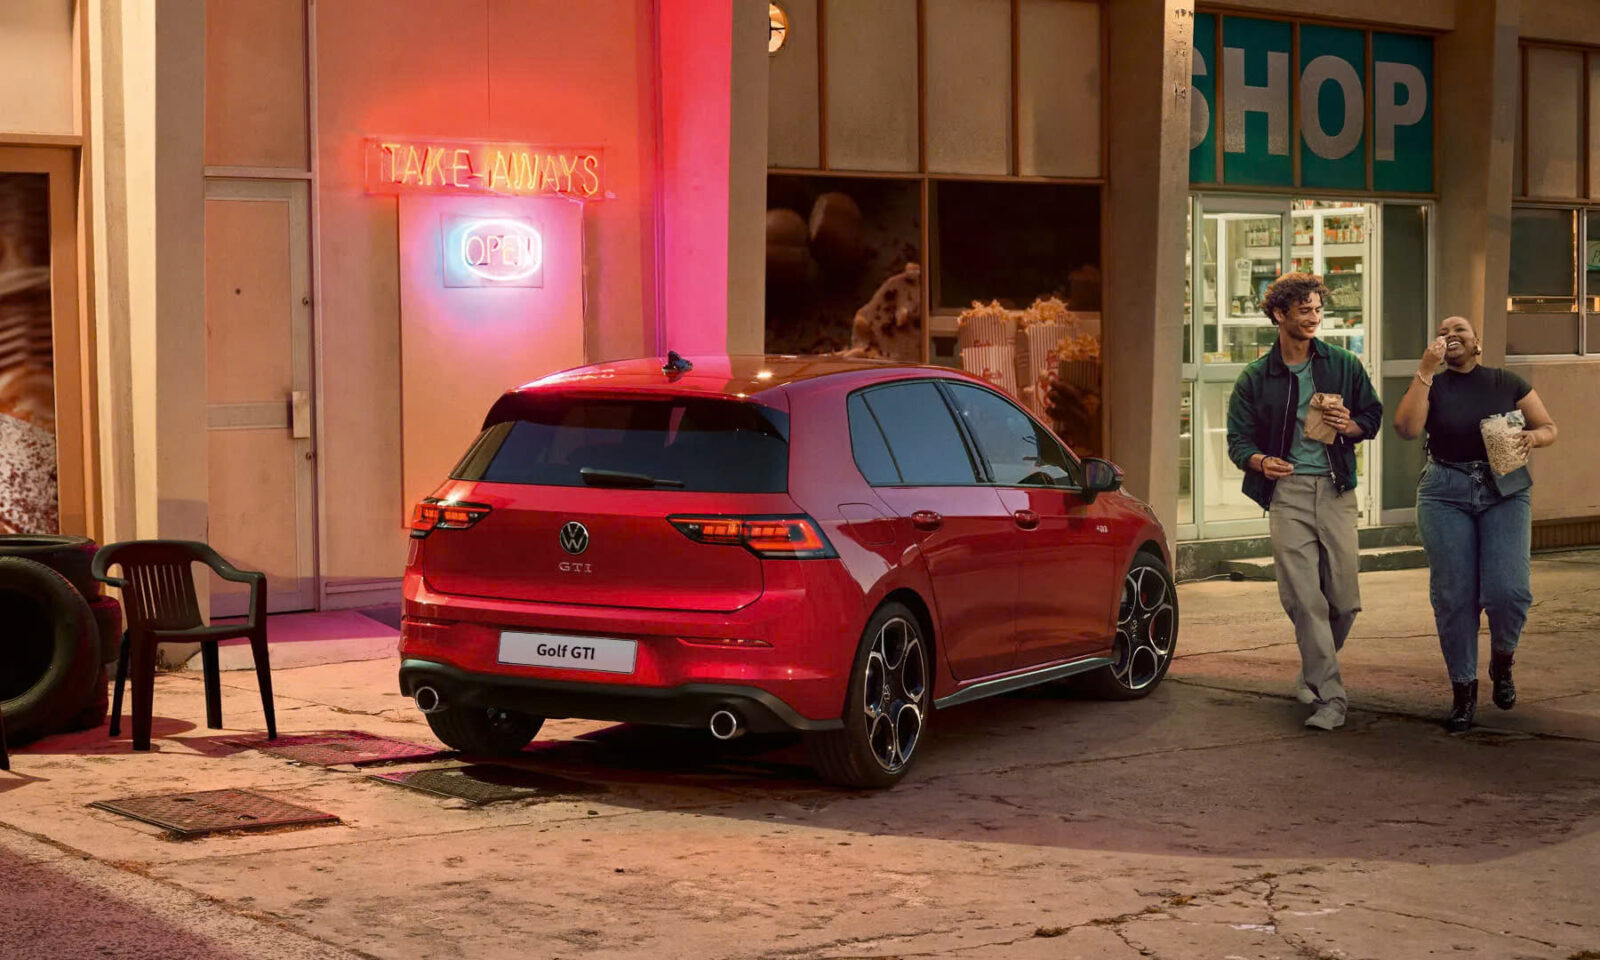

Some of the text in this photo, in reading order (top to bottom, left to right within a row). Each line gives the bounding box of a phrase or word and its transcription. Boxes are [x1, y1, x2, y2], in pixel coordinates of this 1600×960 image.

[382, 144, 598, 194] TAKE-AWAYS
[465, 235, 535, 266] OPEN
[559, 561, 592, 573] GTI
[536, 643, 595, 660] Golf GTI
